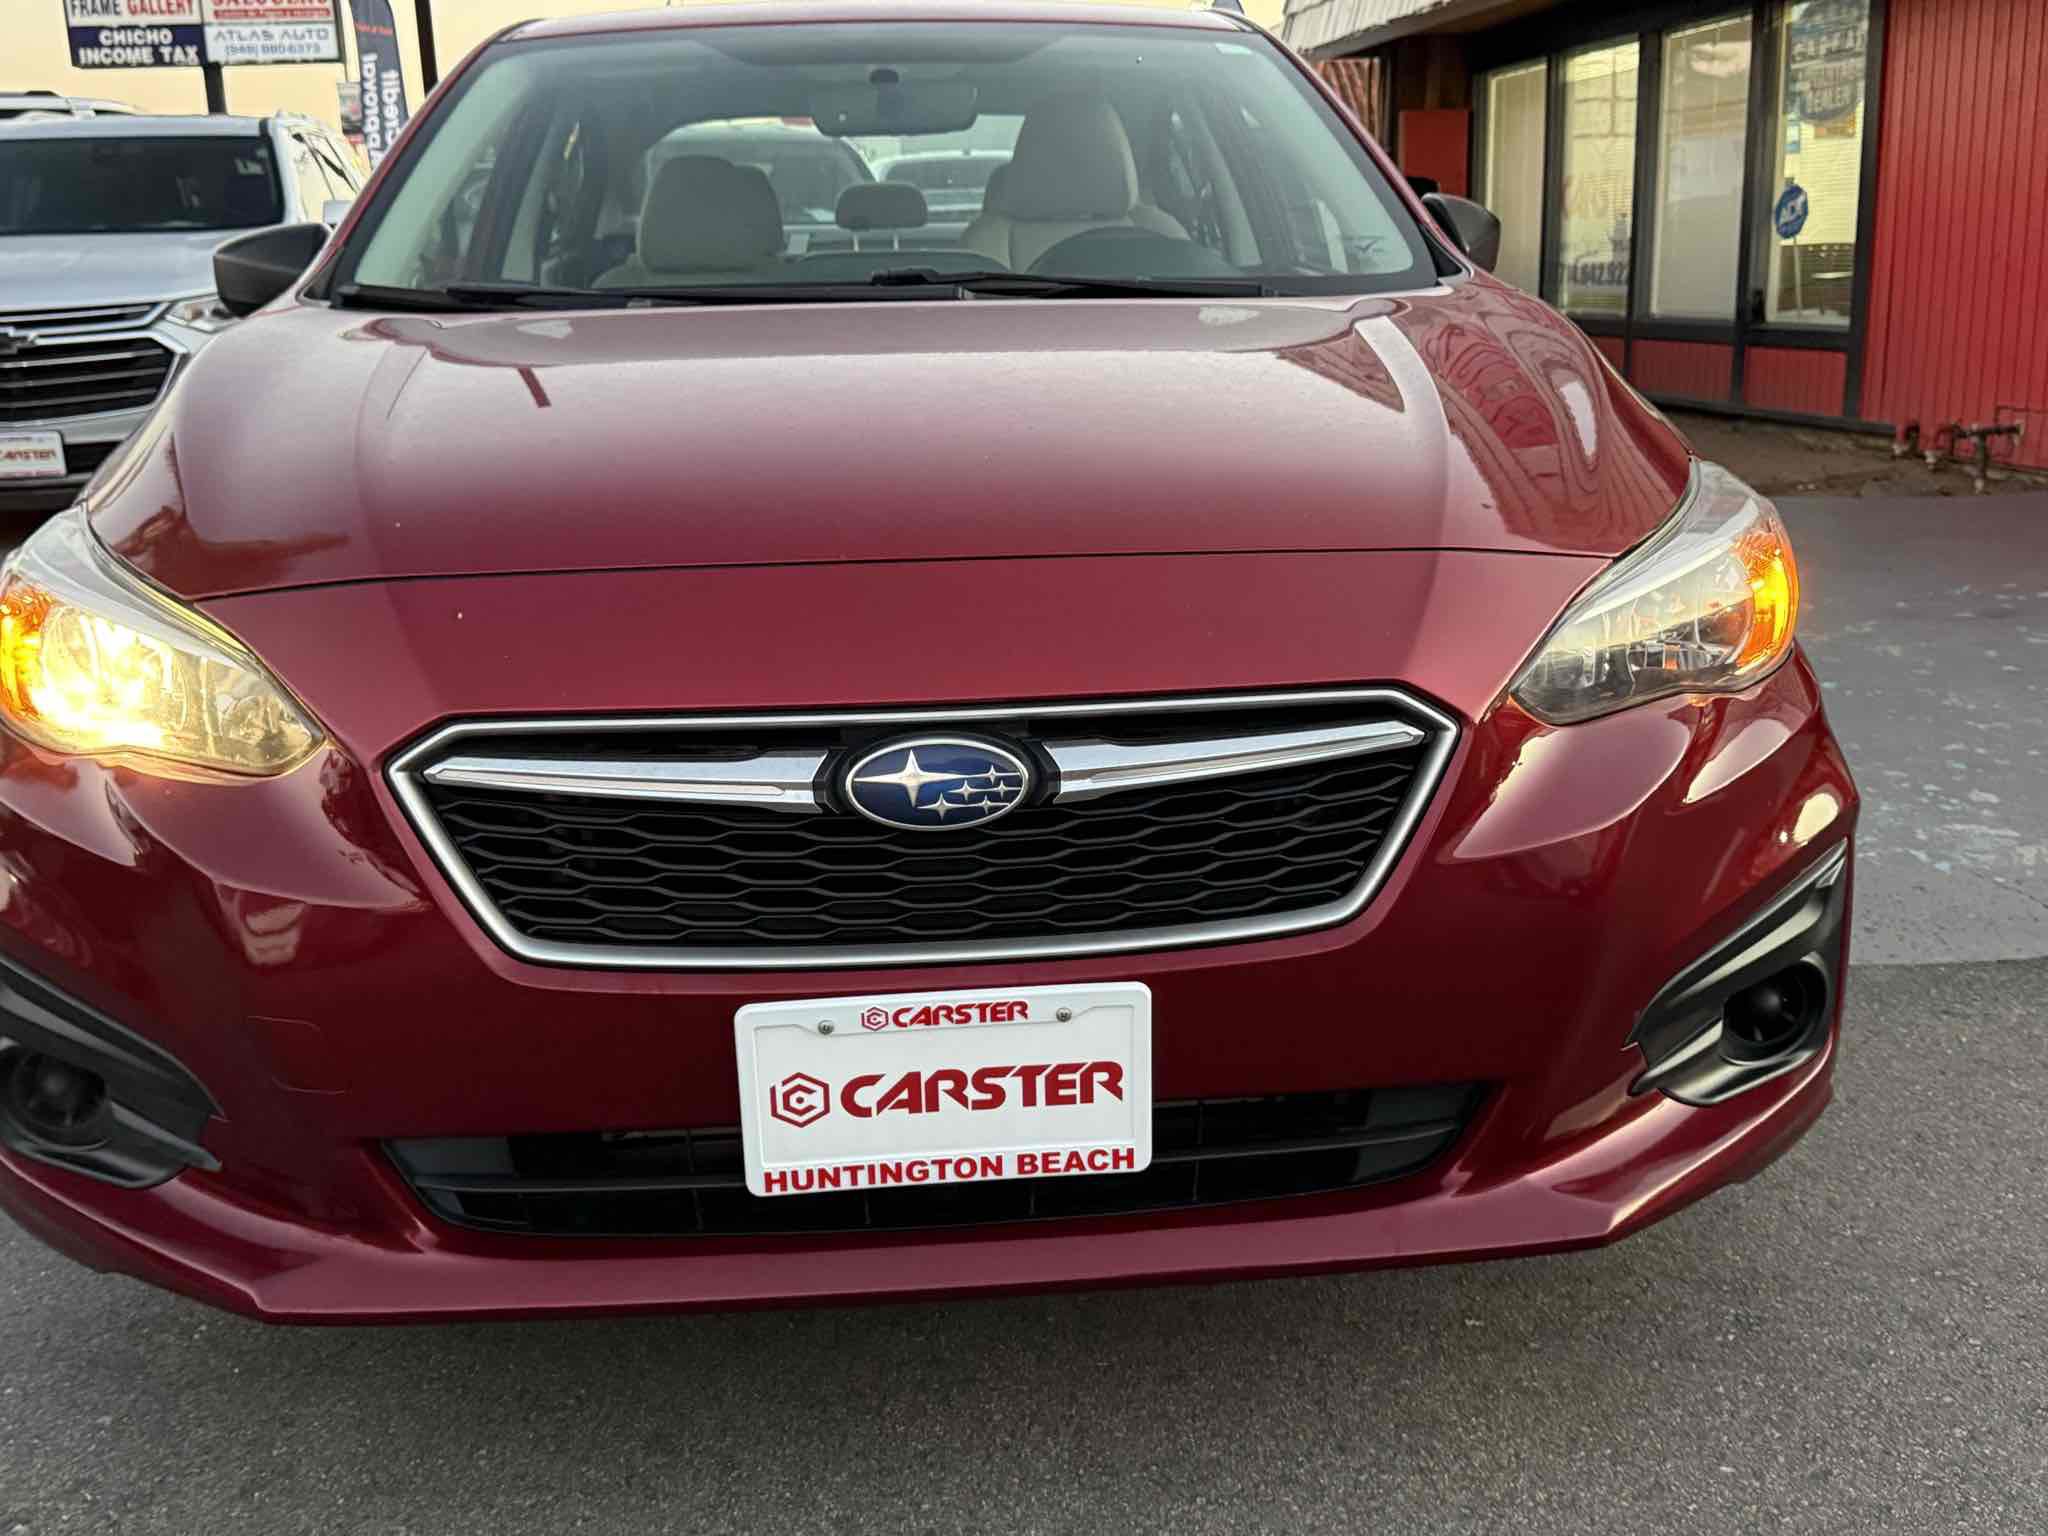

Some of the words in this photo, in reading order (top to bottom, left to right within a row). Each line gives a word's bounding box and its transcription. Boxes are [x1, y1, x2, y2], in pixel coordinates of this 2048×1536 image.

[71, 0, 121, 17] FRAME
[127, 0, 194, 16] GALLERY
[99, 28, 173, 46] CHICHO
[213, 28, 275, 42] ATLAS
[281, 27, 329, 41] AUTO
[78, 46, 154, 65] INCOME
[159, 45, 199, 65] TAX
[892, 1001, 1029, 1028] CARSTER
[840, 1061, 1123, 1118] CARSTER
[763, 1154, 1004, 1193] HUNTINGTON
[1016, 1147, 1135, 1175] BEACH
